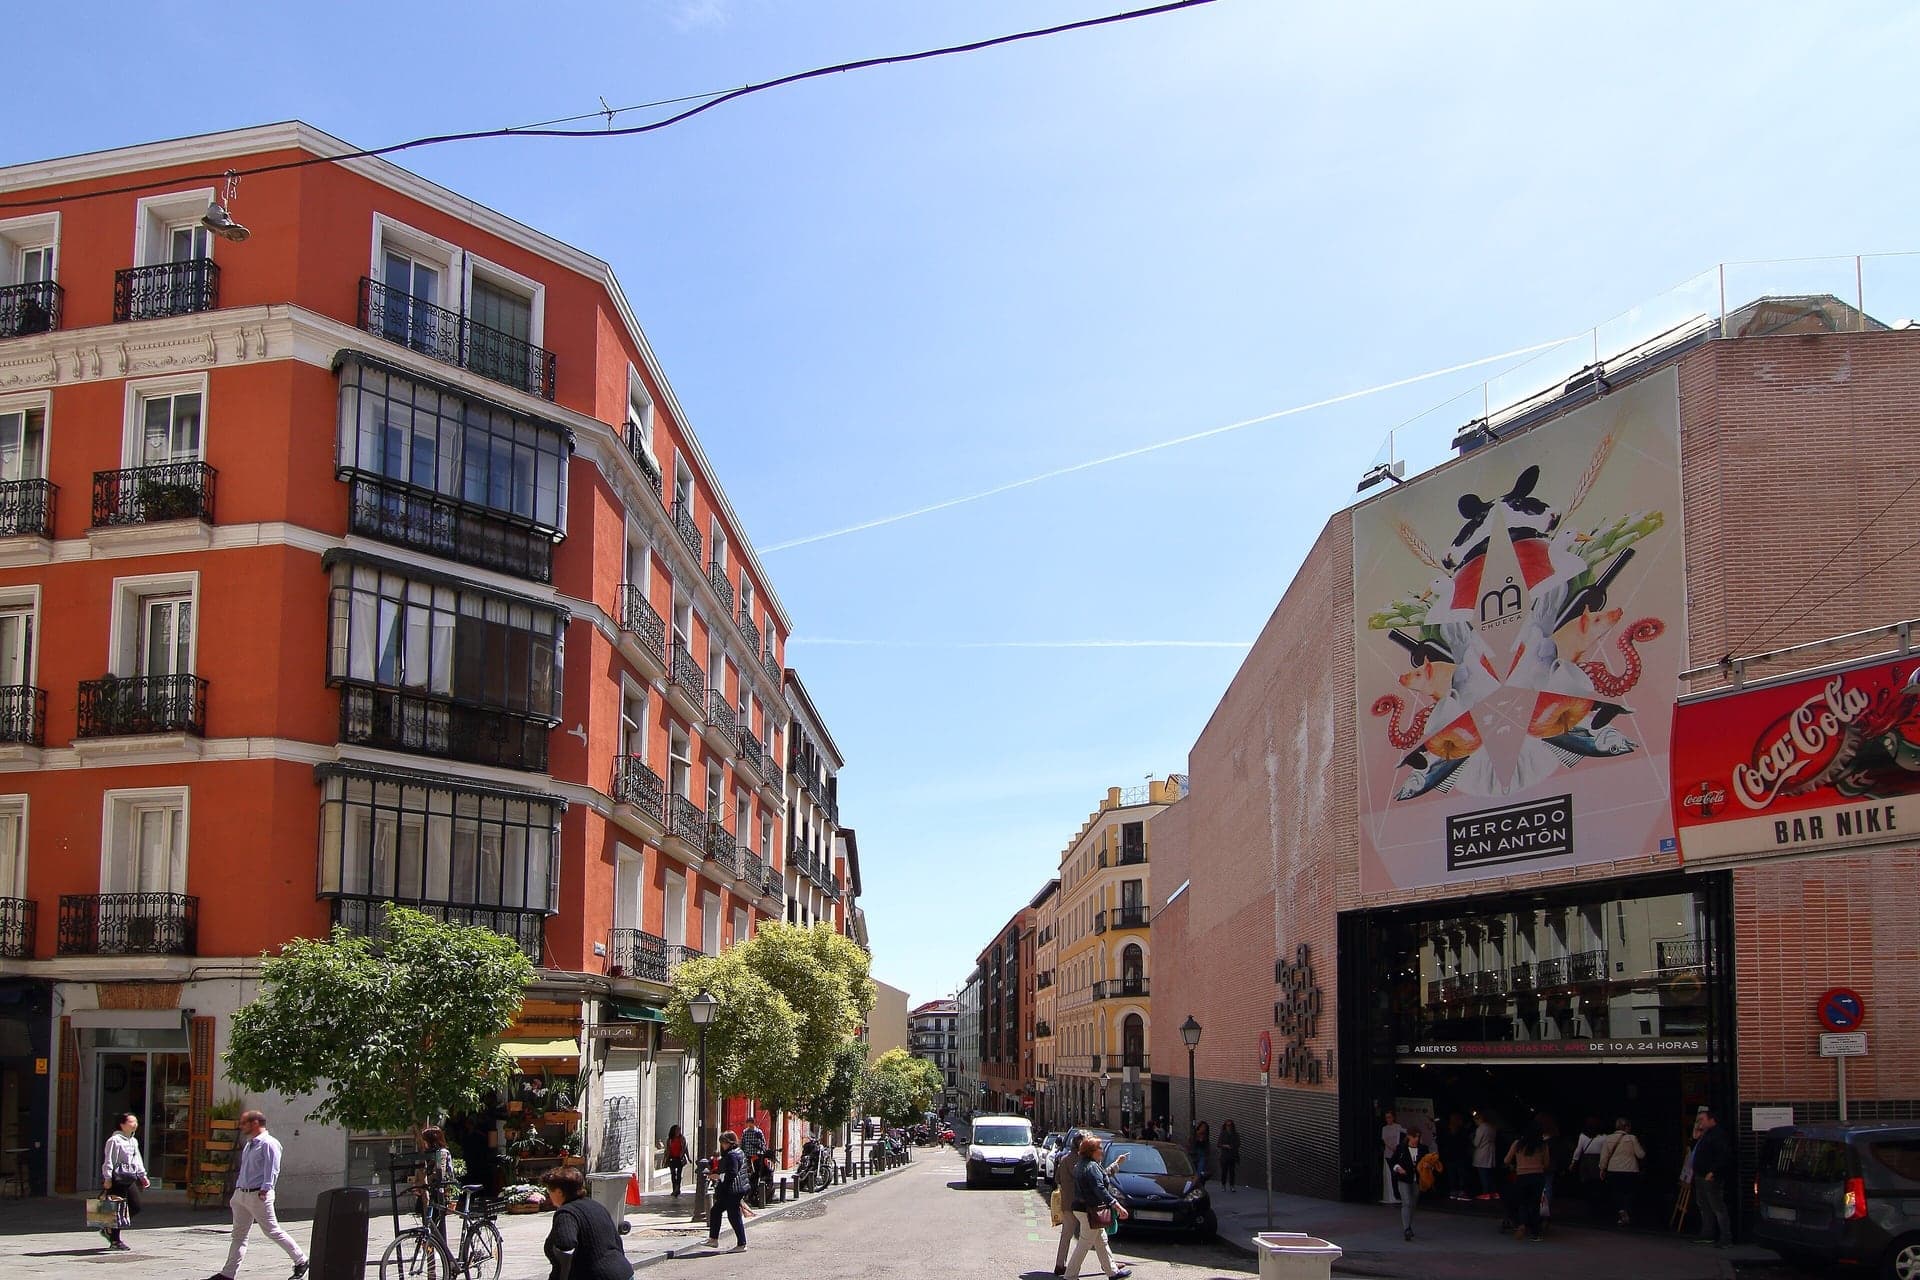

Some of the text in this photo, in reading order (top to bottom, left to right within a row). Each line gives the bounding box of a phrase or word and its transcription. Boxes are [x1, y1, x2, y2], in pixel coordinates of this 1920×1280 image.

[1733, 675, 1869, 810] Coca-Cola
[1452, 810, 1565, 841] MERCADO
[1774, 805, 1897, 845] BAR NIKE
[1454, 840, 1492, 857] SAN
[1414, 1045, 1458, 1053] ABIERTOS
[1589, 1043, 1604, 1051] DE
[1637, 1042, 1654, 1050] 24
[1657, 1041, 1699, 1050] HORAS
